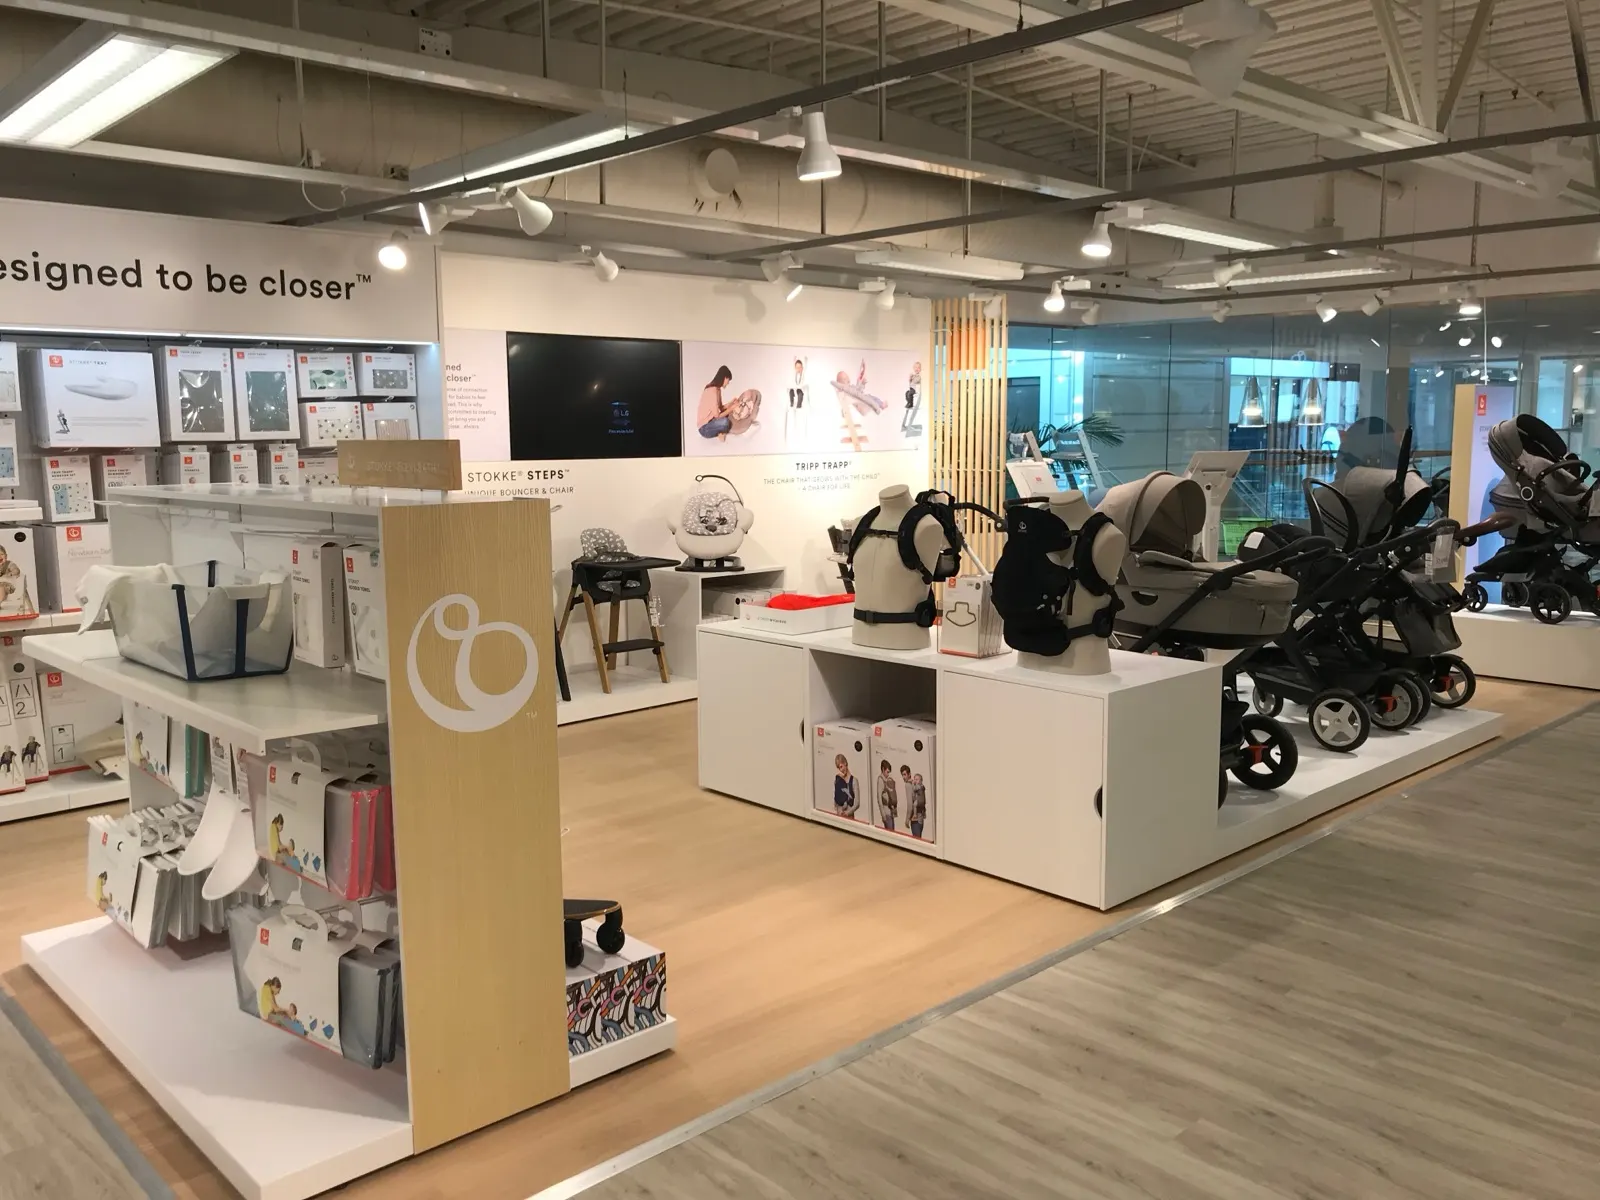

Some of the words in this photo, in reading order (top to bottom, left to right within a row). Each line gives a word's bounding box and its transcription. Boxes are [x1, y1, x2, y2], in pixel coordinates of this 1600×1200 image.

[156, 264, 193, 291] to
[206, 264, 248, 295] be
[796, 462, 820, 471] TRIPP
[776, 477, 795, 485] CHAIR
[849, 473, 860, 481] THE
[500, 487, 539, 497] BOUNCER
[542, 487, 547, 495] &
[549, 486, 574, 495] CHAIR
[15, 701, 27, 716] 2
[57, 747, 64, 760] 1
